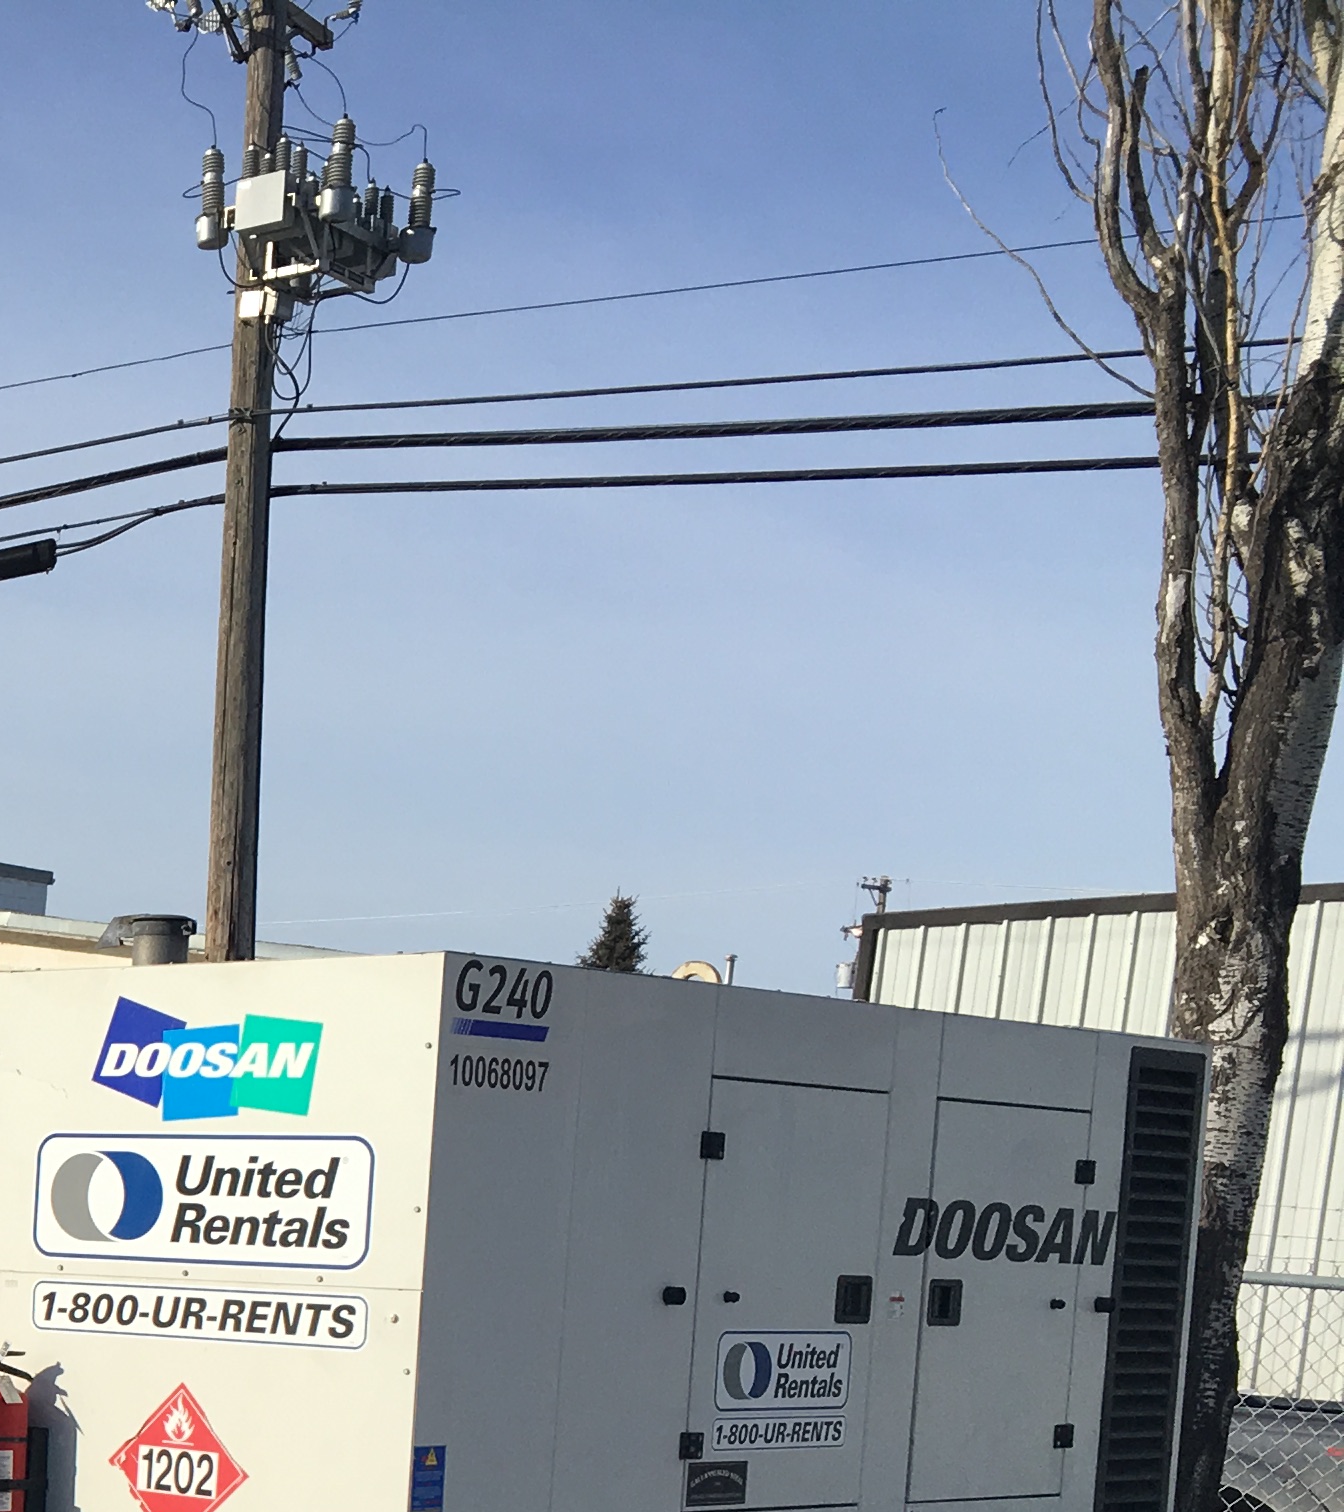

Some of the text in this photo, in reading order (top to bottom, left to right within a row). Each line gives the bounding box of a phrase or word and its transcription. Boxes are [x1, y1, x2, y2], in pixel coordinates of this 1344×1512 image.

[455, 959, 554, 1019] G240
[99, 1041, 315, 1079] DOOSAN
[449, 1053, 550, 1092] 10068097
[174, 1154, 341, 1200] United
[169, 1202, 351, 1250] Rentals
[892, 1197, 1118, 1266] DOOSAN
[40, 1291, 357, 1340] 1-800-UR-RENTS
[776, 1342, 841, 1370] United
[773, 1371, 844, 1399] Rentals
[715, 1420, 843, 1445] 1-800-UR-RENTS
[141, 1447, 214, 1497] 1202
